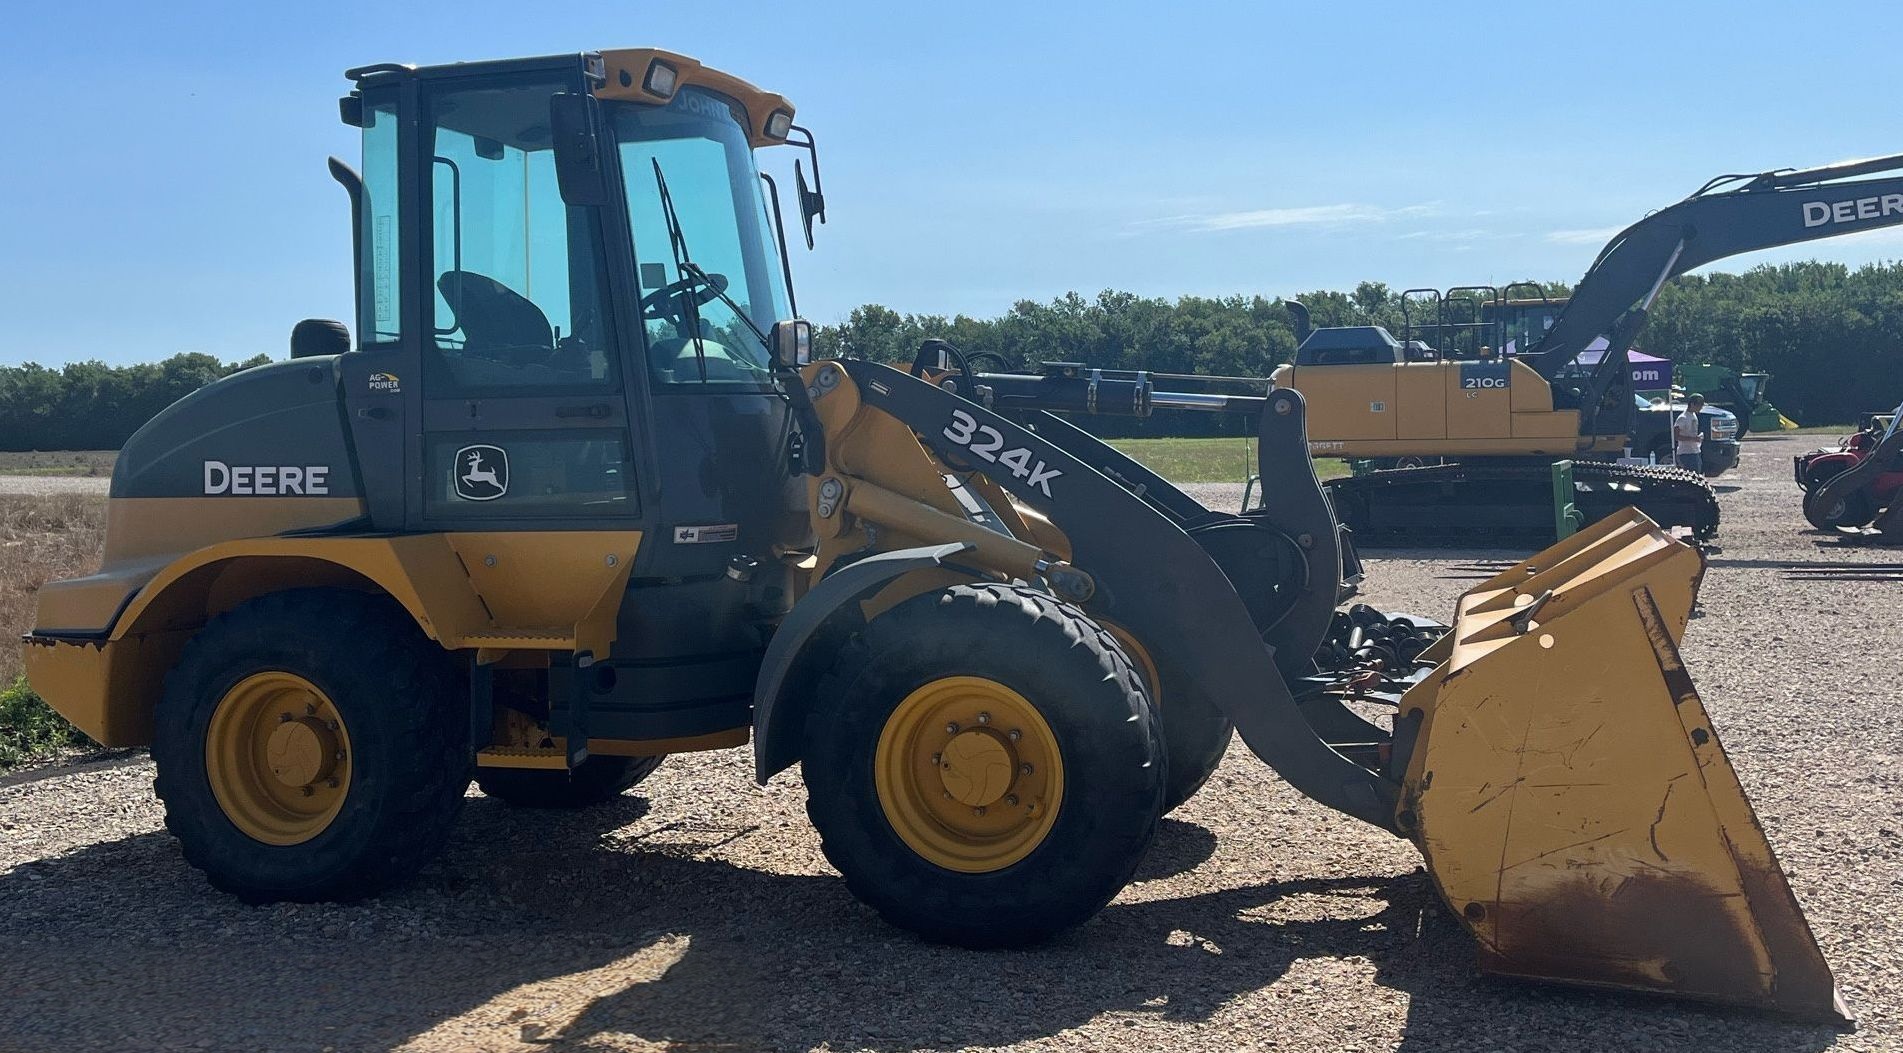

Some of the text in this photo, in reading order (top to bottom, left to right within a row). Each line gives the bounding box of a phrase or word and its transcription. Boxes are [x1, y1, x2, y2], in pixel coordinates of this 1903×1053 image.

[369, 381, 399, 390] POWER
[1465, 377, 1505, 389] 210G
[942, 409, 1064, 499] 324K
[204, 460, 329, 495] DEERE
